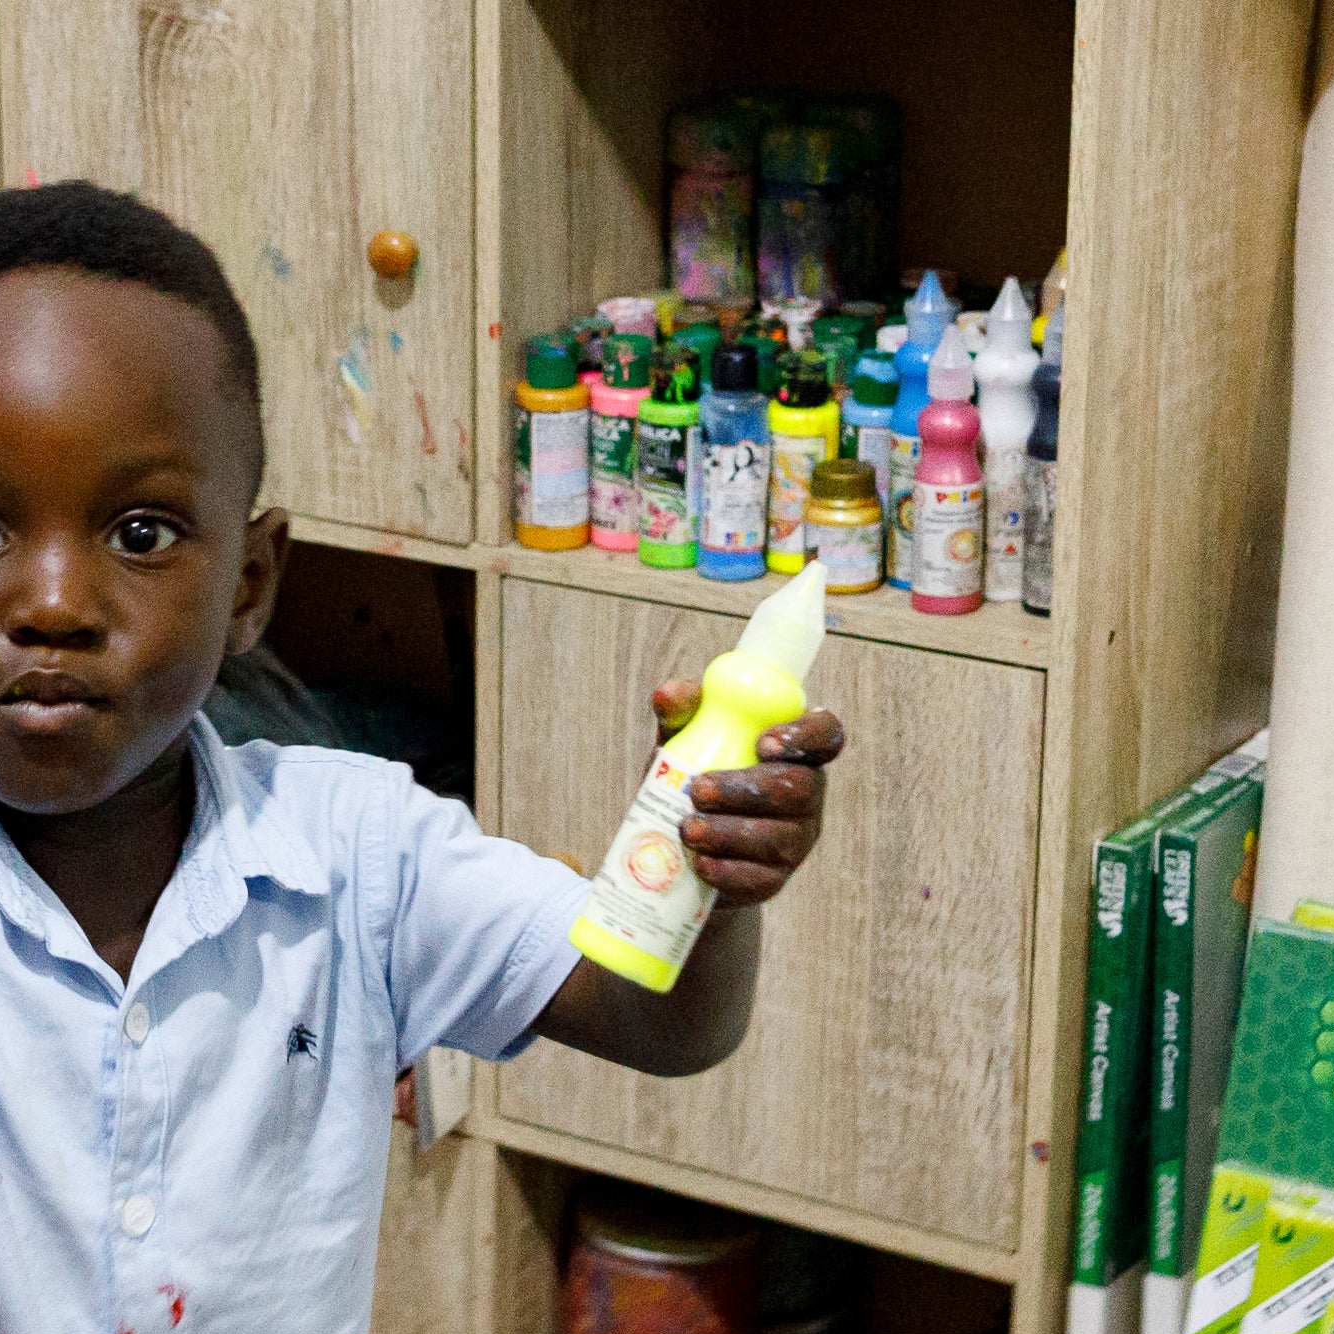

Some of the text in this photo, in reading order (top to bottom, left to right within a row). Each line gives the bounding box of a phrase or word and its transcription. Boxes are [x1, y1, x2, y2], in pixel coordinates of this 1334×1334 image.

[1087, 1000, 1111, 1122] Artist Canvas
[1160, 989, 1180, 1110] Artist Canvas
